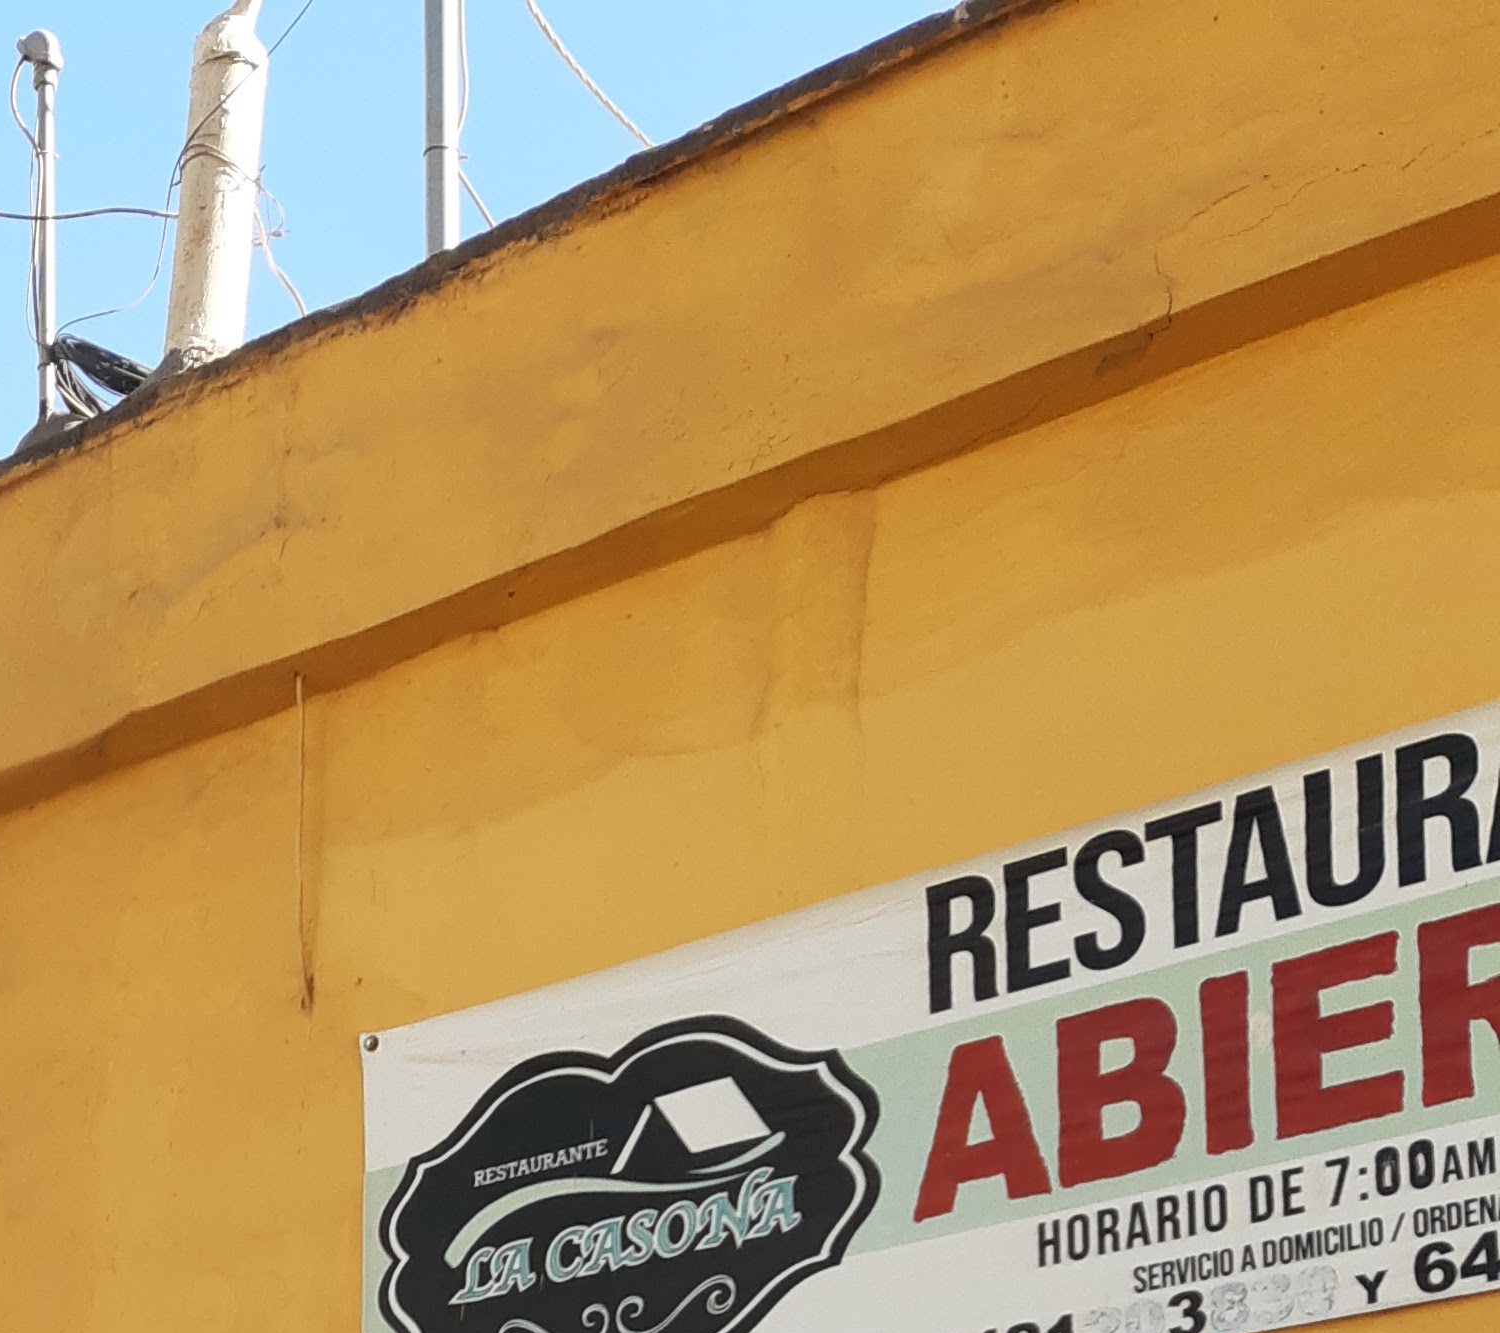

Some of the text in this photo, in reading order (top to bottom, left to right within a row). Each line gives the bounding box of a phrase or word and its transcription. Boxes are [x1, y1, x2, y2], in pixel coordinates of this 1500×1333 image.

[925, 733, 1500, 1014] RESTAUR
[473, 1138, 609, 1188] RESTAURANTE
[448, 1166, 803, 1305] LA CASONA
[1037, 1184, 1228, 1268] HORARIO
[1248, 1166, 1306, 1224] DE
[1132, 1193, 1500, 1293] SERVICIO A DOMICILIO / ORDEN
[1355, 1269, 1388, 1305] Y
